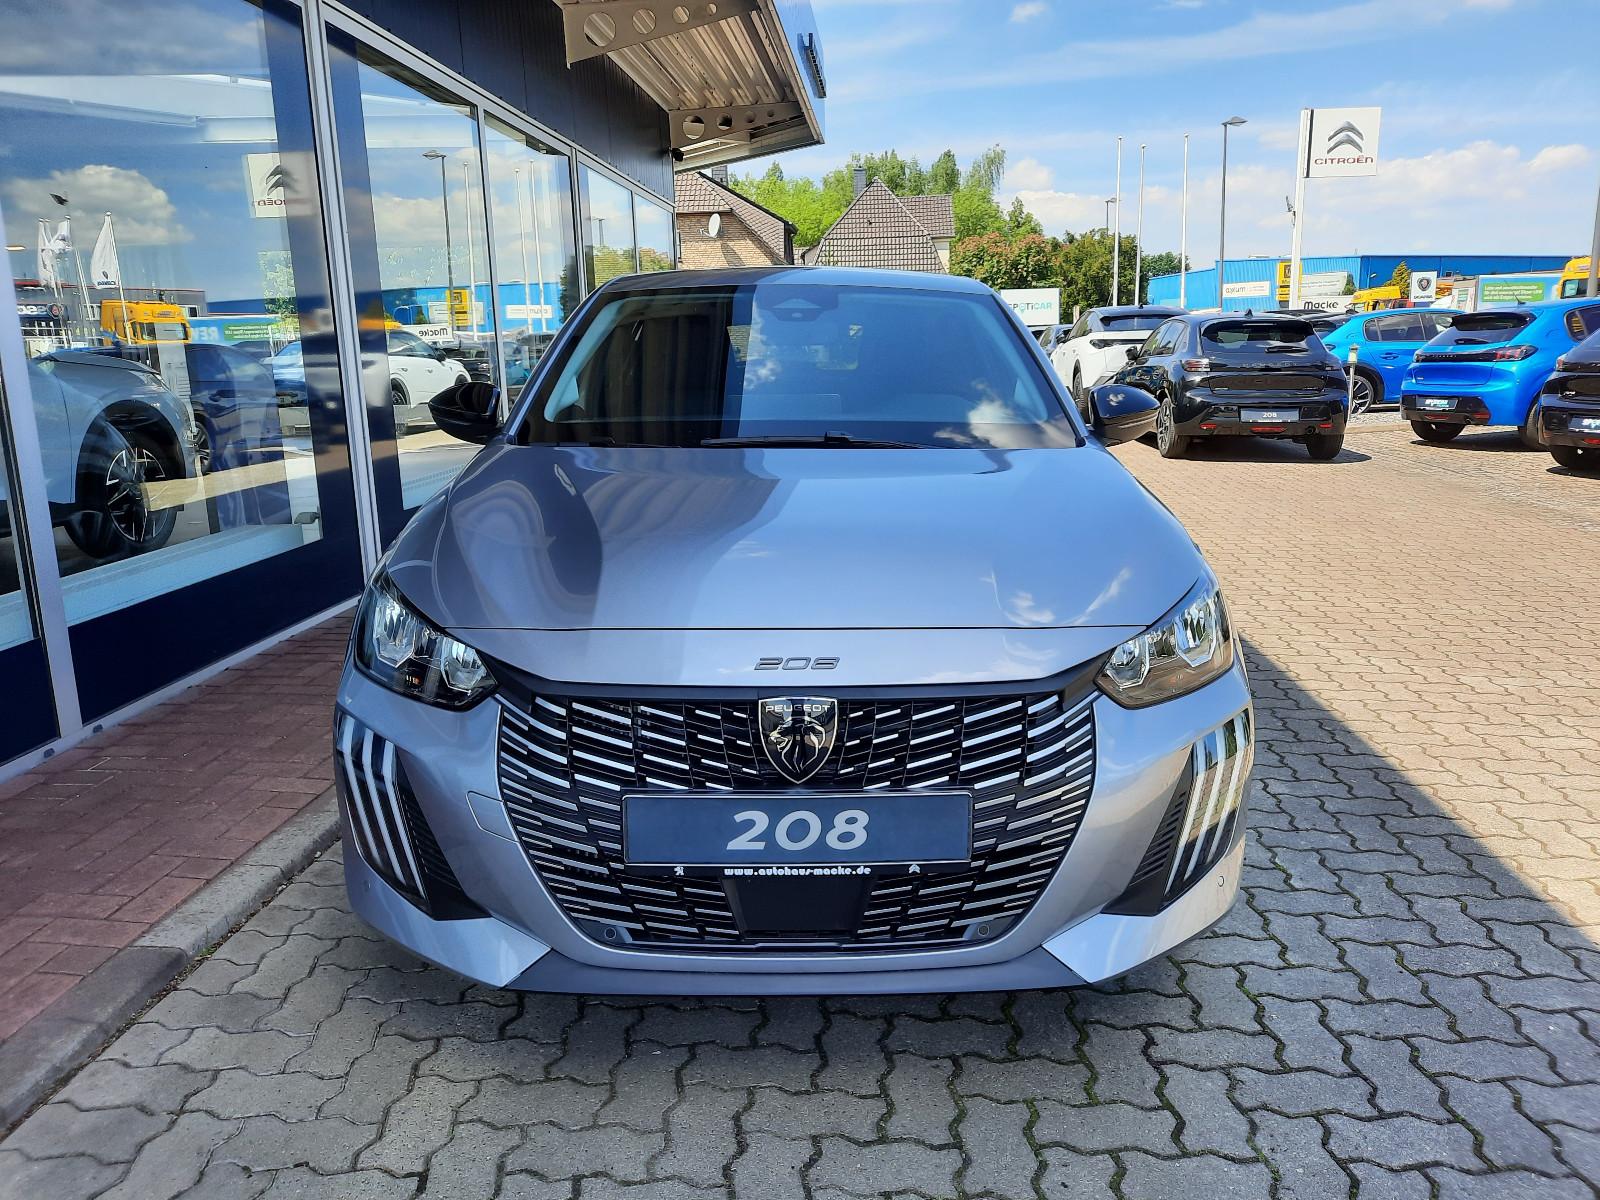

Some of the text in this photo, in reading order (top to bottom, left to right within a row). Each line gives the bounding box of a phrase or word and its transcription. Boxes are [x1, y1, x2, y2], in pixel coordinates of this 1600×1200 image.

[1304, 300, 1339, 310] Macke
[754, 656, 841, 671] 208
[765, 704, 831, 713] PEUGEOT
[726, 809, 870, 851] 208
[723, 865, 872, 877] www.autohaus-macke.de
